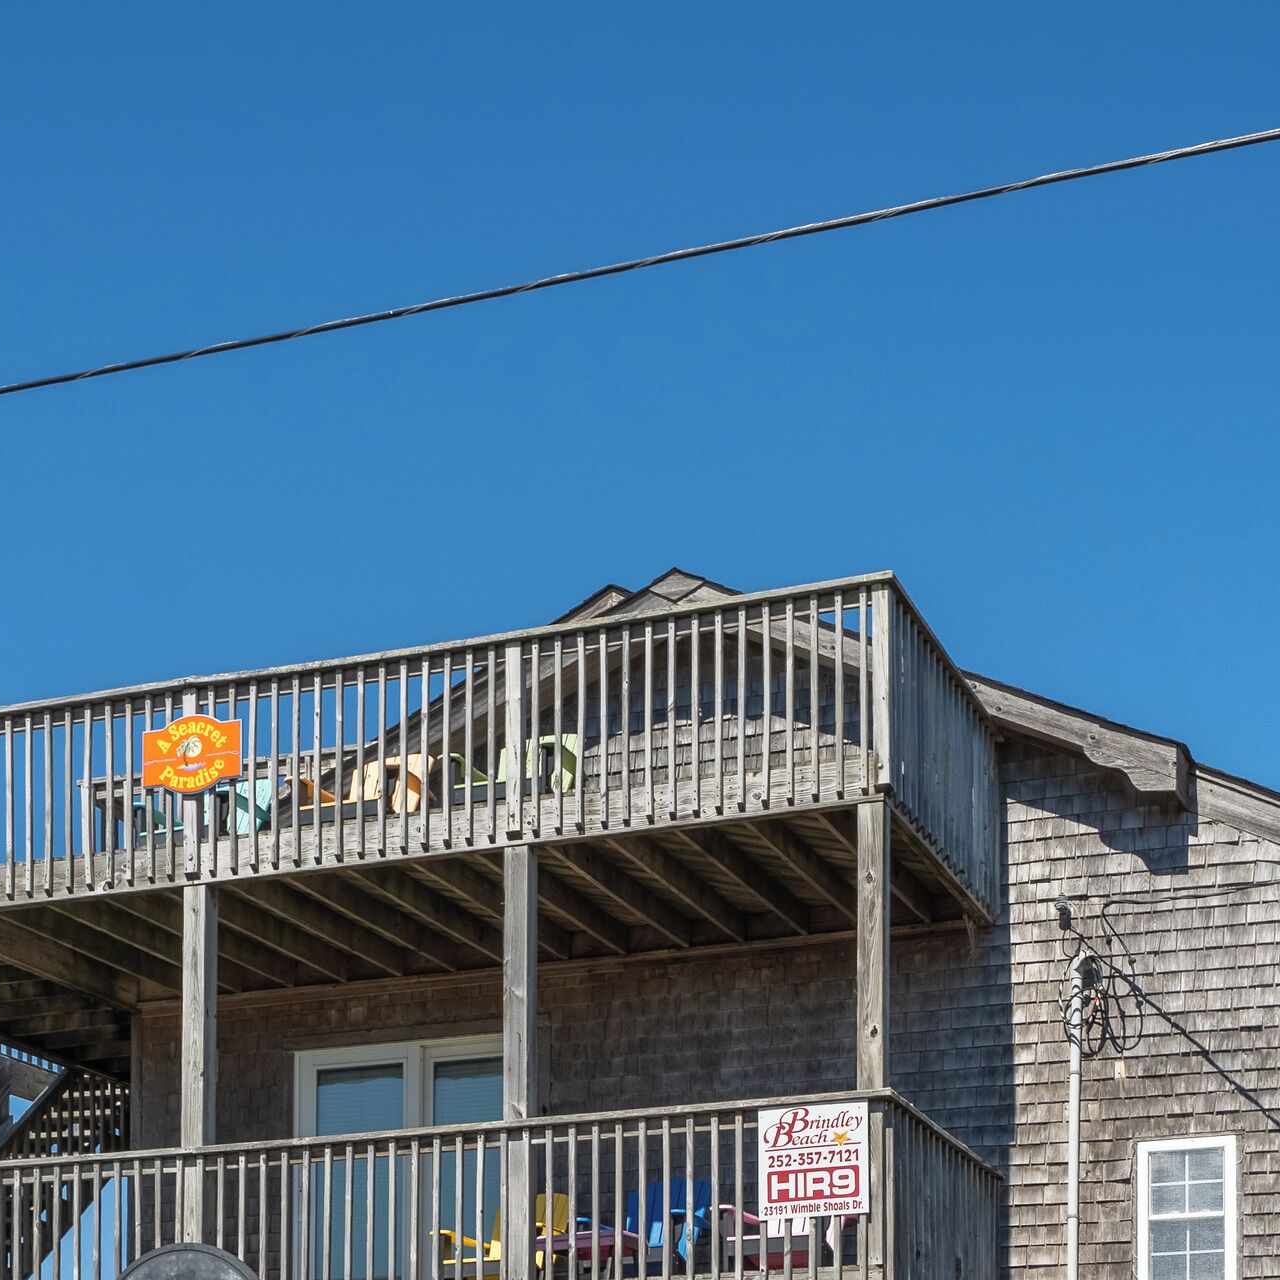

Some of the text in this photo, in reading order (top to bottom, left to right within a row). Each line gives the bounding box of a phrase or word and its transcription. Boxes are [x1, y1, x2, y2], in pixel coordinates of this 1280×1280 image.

[156, 721, 228, 755] A Seacret
[159, 759, 225, 789] Paradise
[780, 1107, 863, 1133] Brindley
[763, 1122, 829, 1148] Beach
[768, 1148, 859, 1168] 252-357-7121
[770, 1168, 856, 1200] HIR9
[763, 1200, 864, 1216] 23191 Wimble Shoals Dr.
